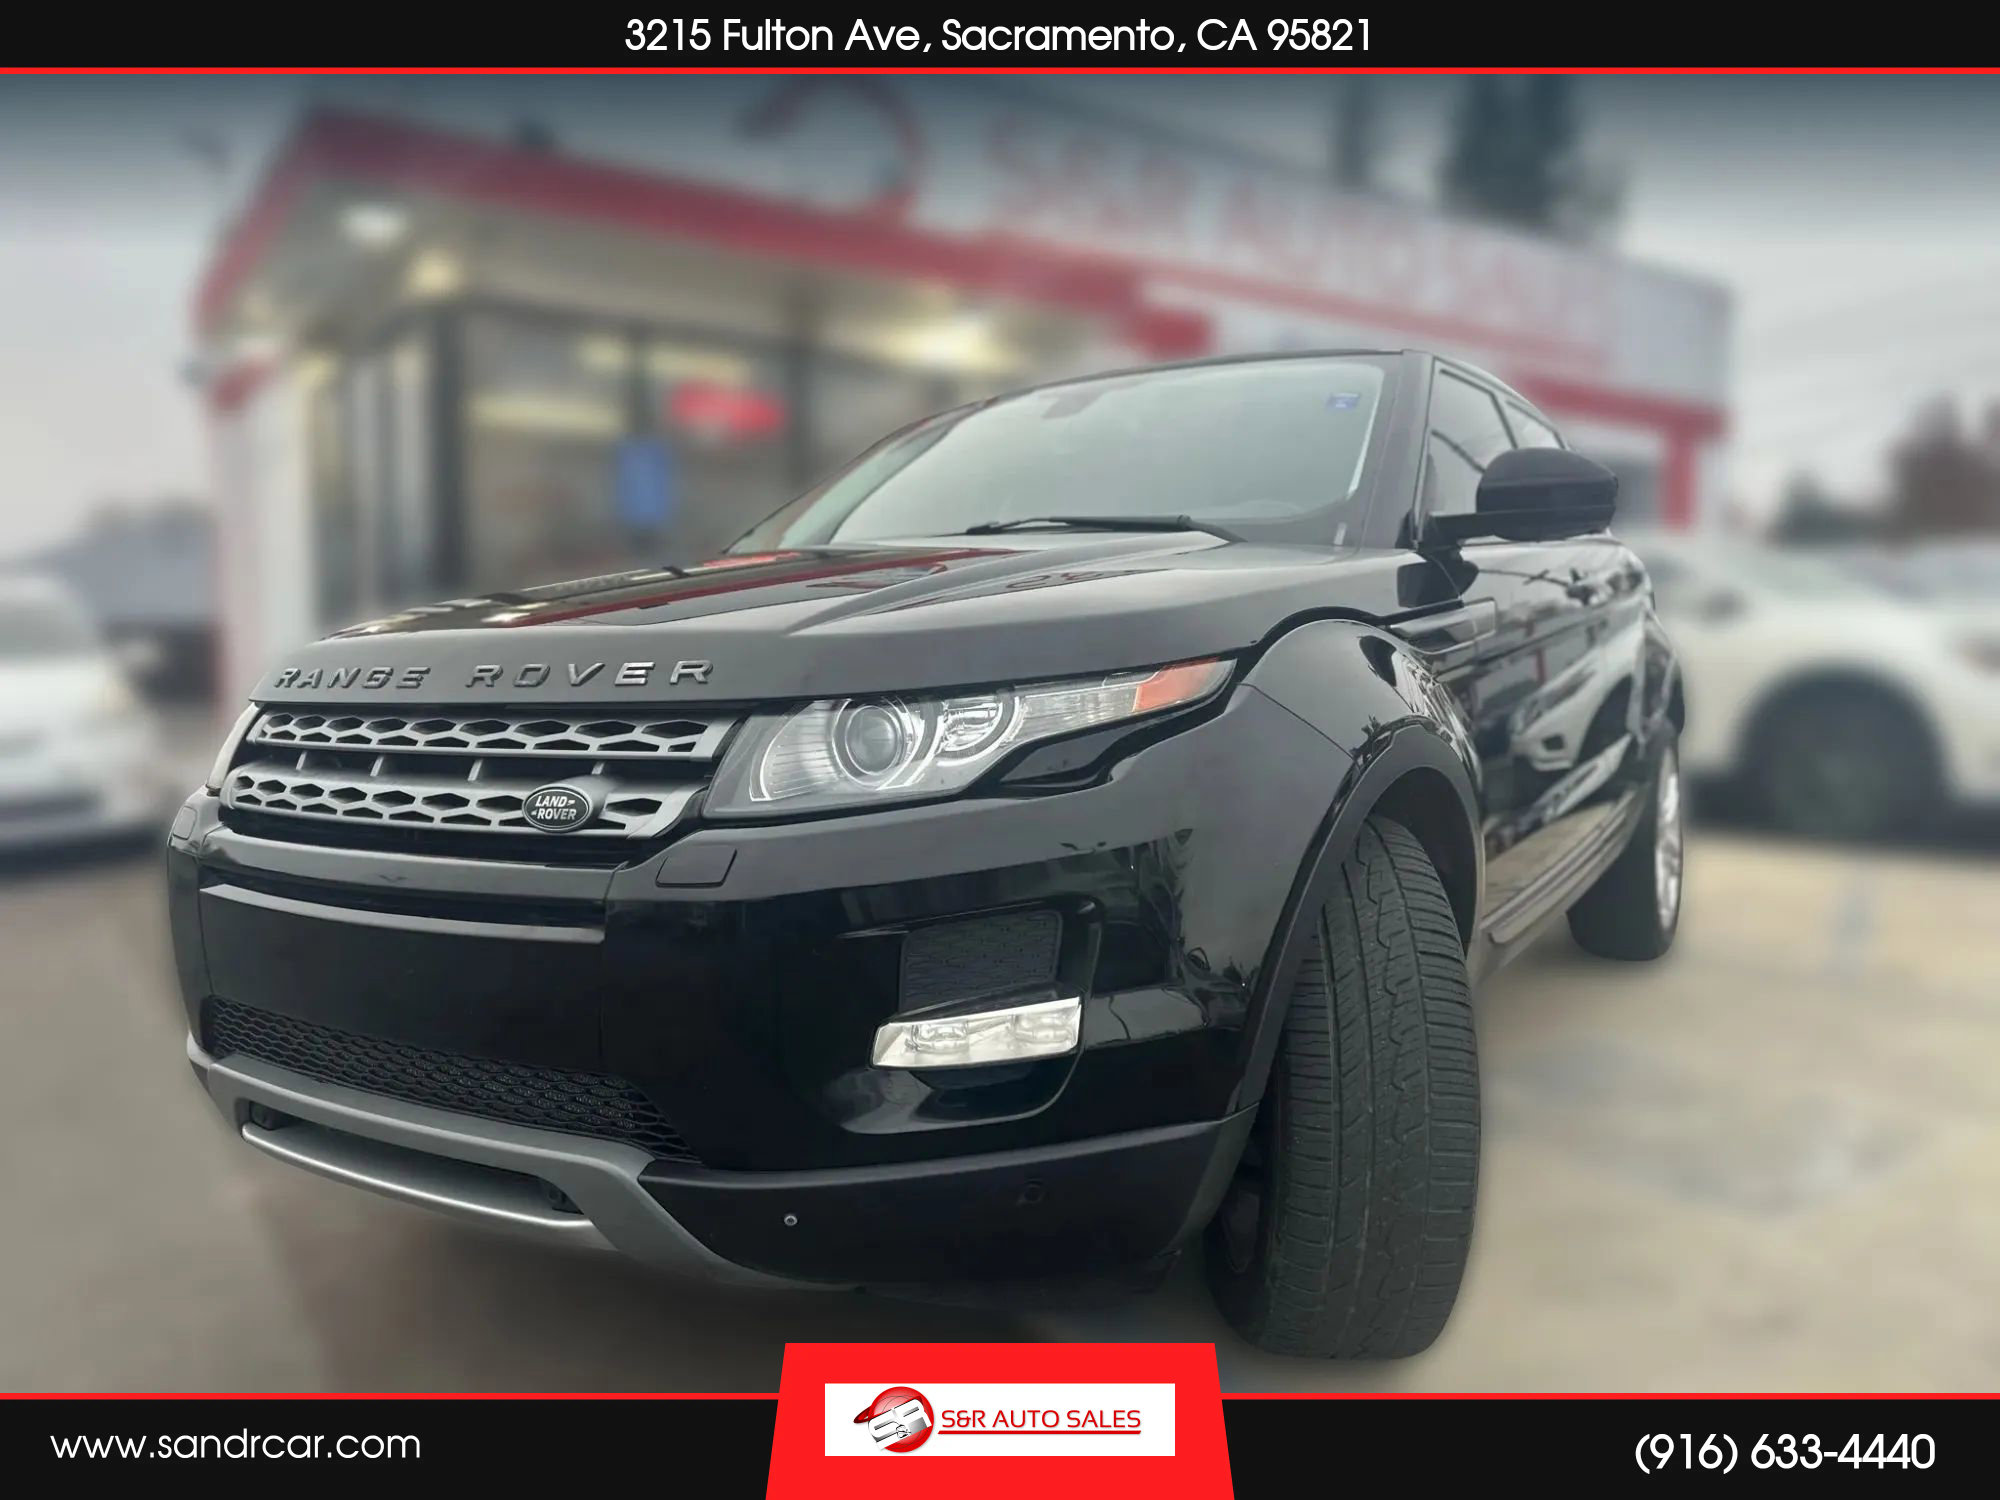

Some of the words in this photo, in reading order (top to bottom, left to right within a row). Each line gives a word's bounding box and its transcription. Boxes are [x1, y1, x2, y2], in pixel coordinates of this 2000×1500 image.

[274, 667, 431, 689] RANGE
[465, 659, 714, 688] ROVER
[535, 795, 568, 808] LAND
[537, 808, 577, 820] ROVER
